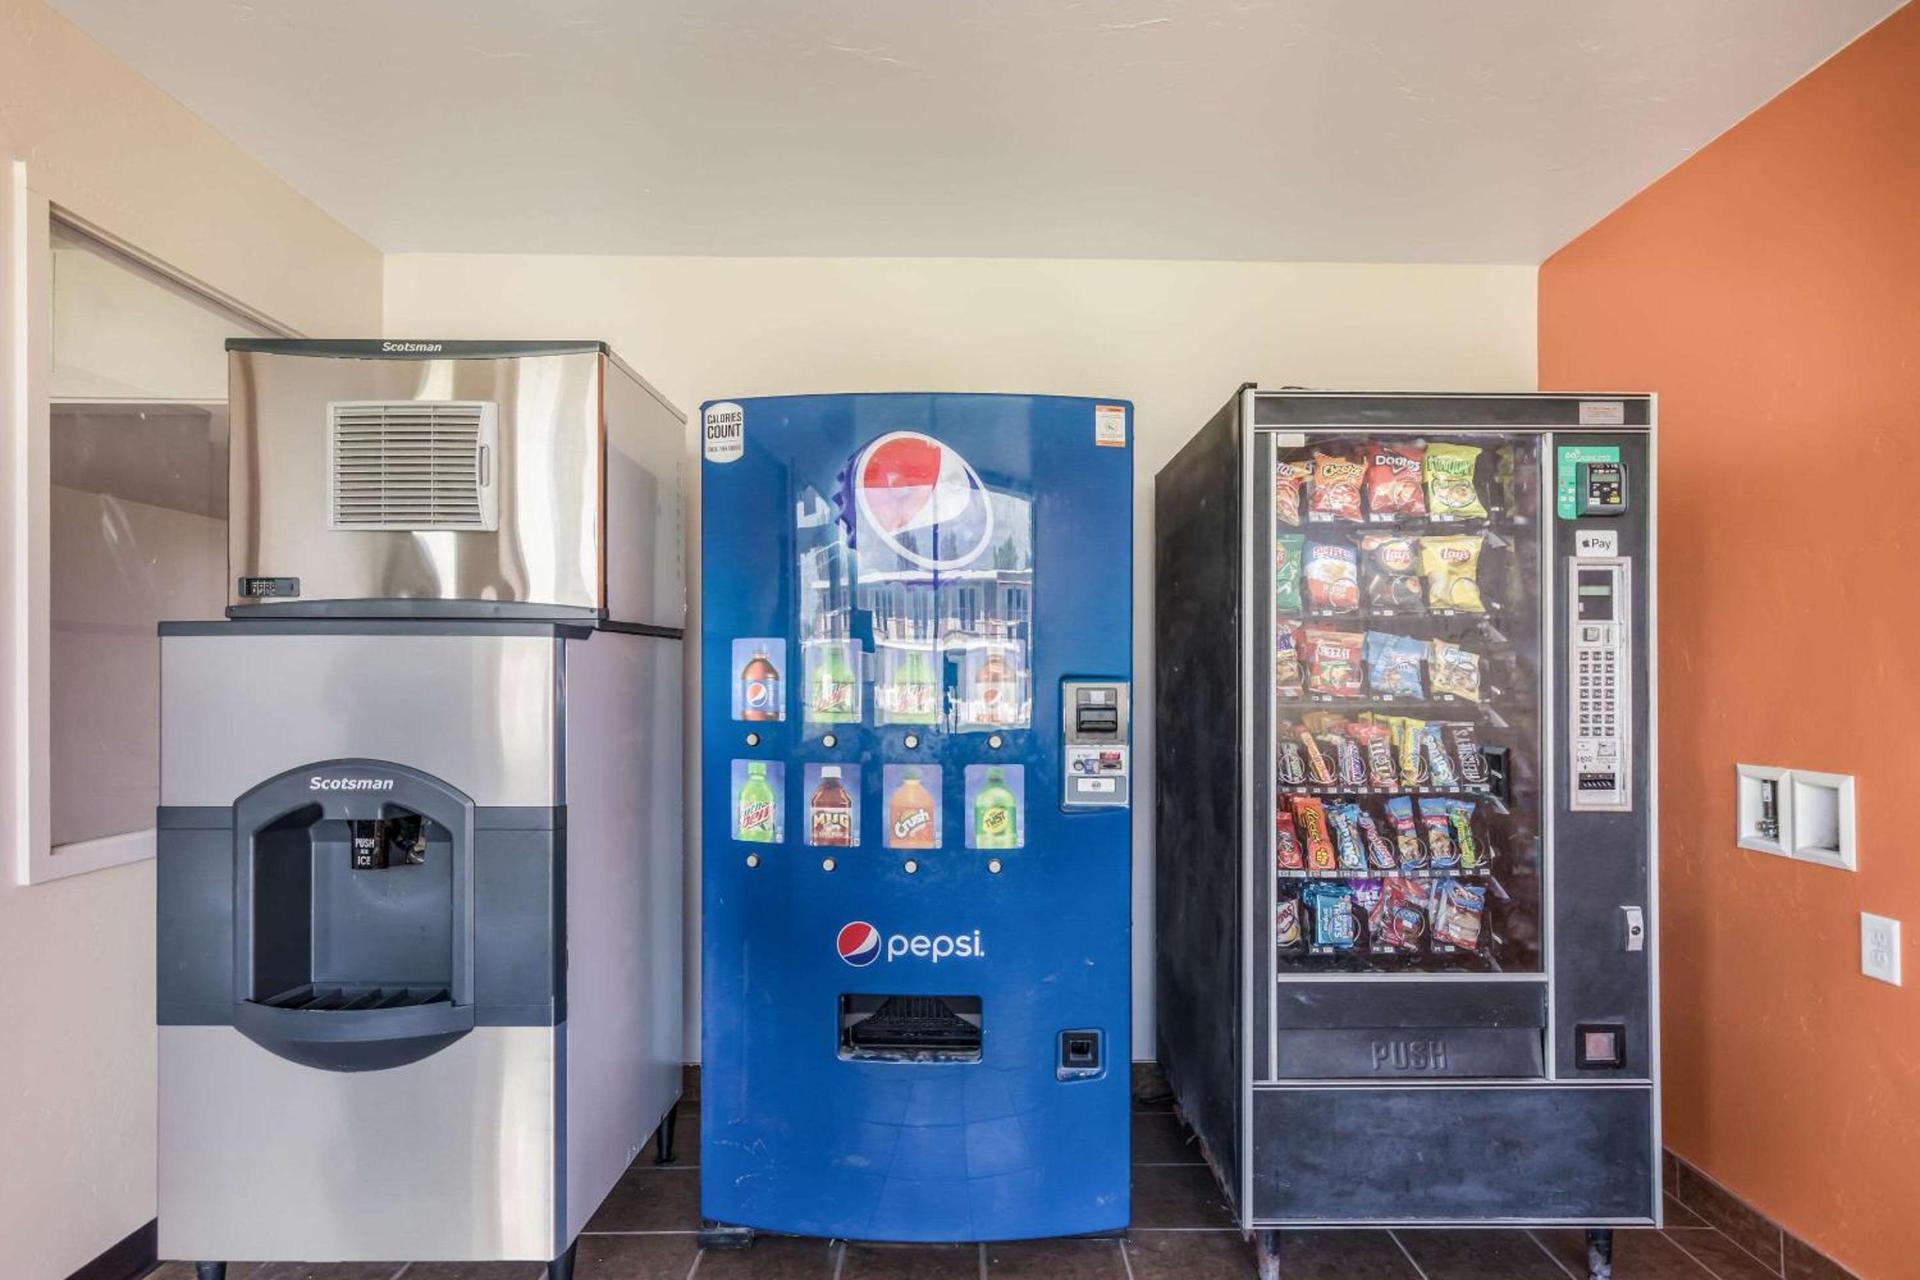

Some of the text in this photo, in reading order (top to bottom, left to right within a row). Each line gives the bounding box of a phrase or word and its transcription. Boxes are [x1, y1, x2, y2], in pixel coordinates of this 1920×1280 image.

[382, 341, 442, 352] Scotsman
[707, 423, 742, 439] COUNT
[1591, 538, 1612, 550] Pay
[309, 776, 394, 791] Scotsman
[813, 811, 850, 826] MUG
[894, 809, 929, 838] Crush
[355, 838, 375, 848] PUSH
[357, 856, 372, 866] ICE
[1371, 1041, 1448, 1071] PUSH
